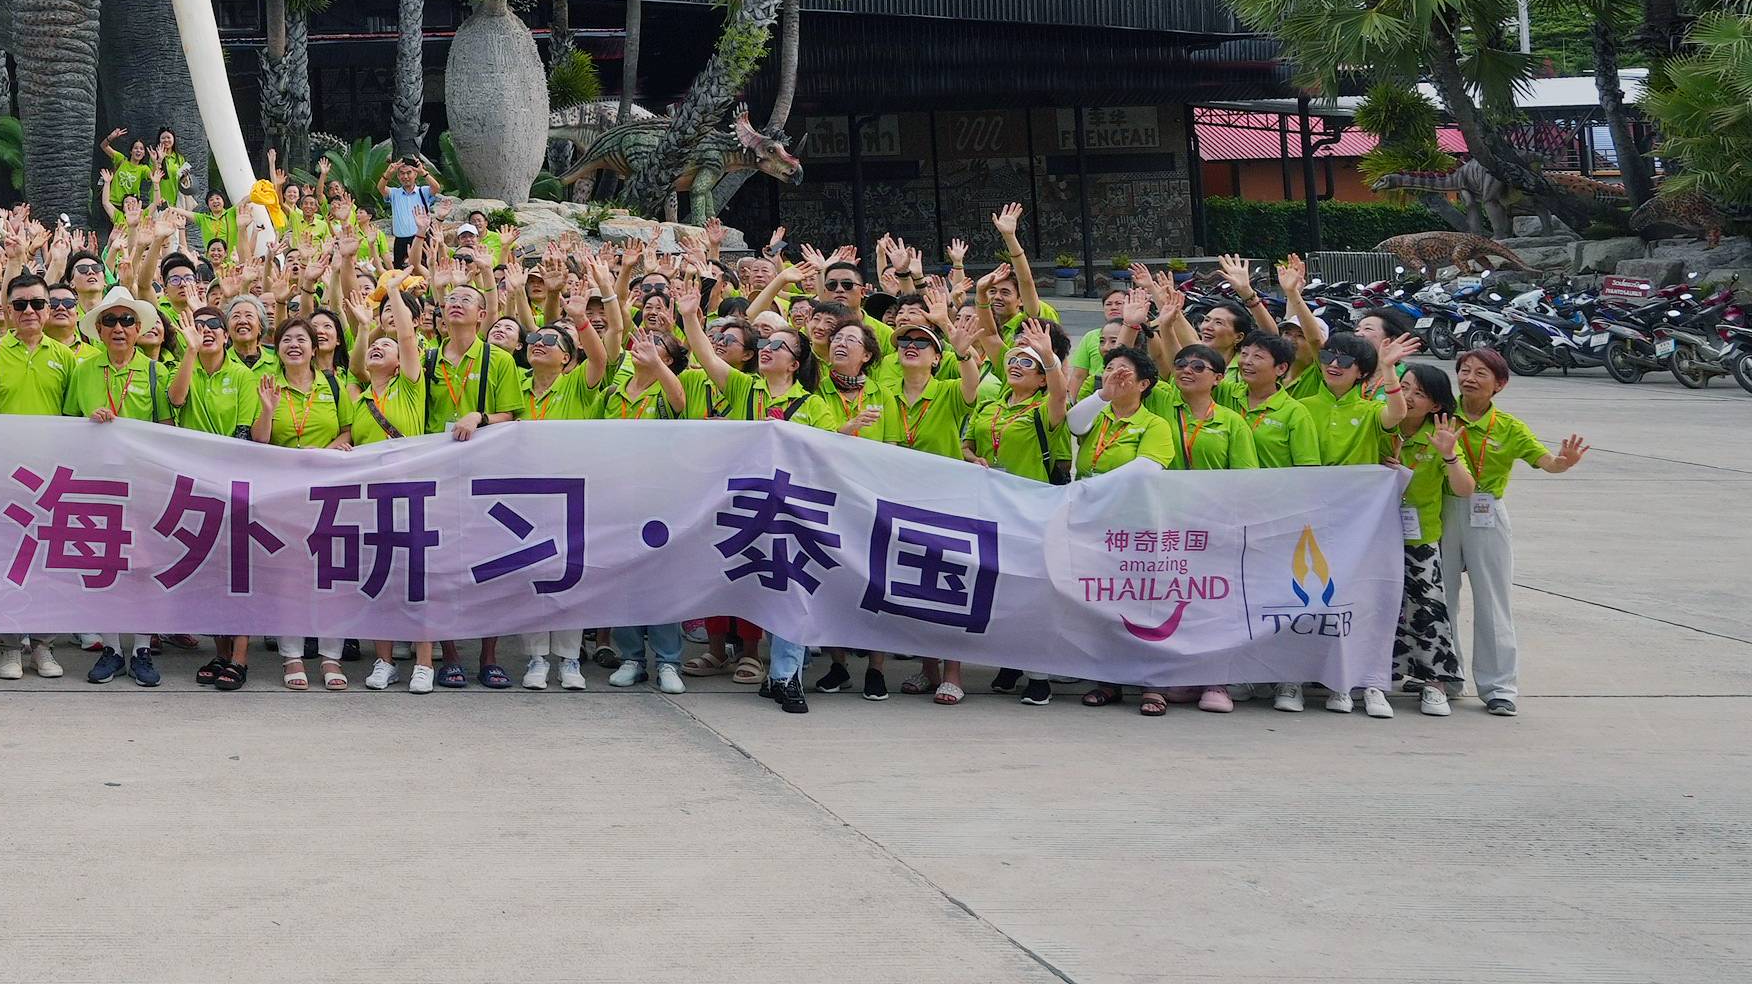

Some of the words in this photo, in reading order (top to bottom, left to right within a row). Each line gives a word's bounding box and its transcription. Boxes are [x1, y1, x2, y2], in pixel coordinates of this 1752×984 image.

[1104, 529, 1209, 553] 神奇泰国
[1119, 556, 1188, 574] amazing
[1079, 576, 1230, 601] THAILAND
[1261, 610, 1353, 638] TCEB
